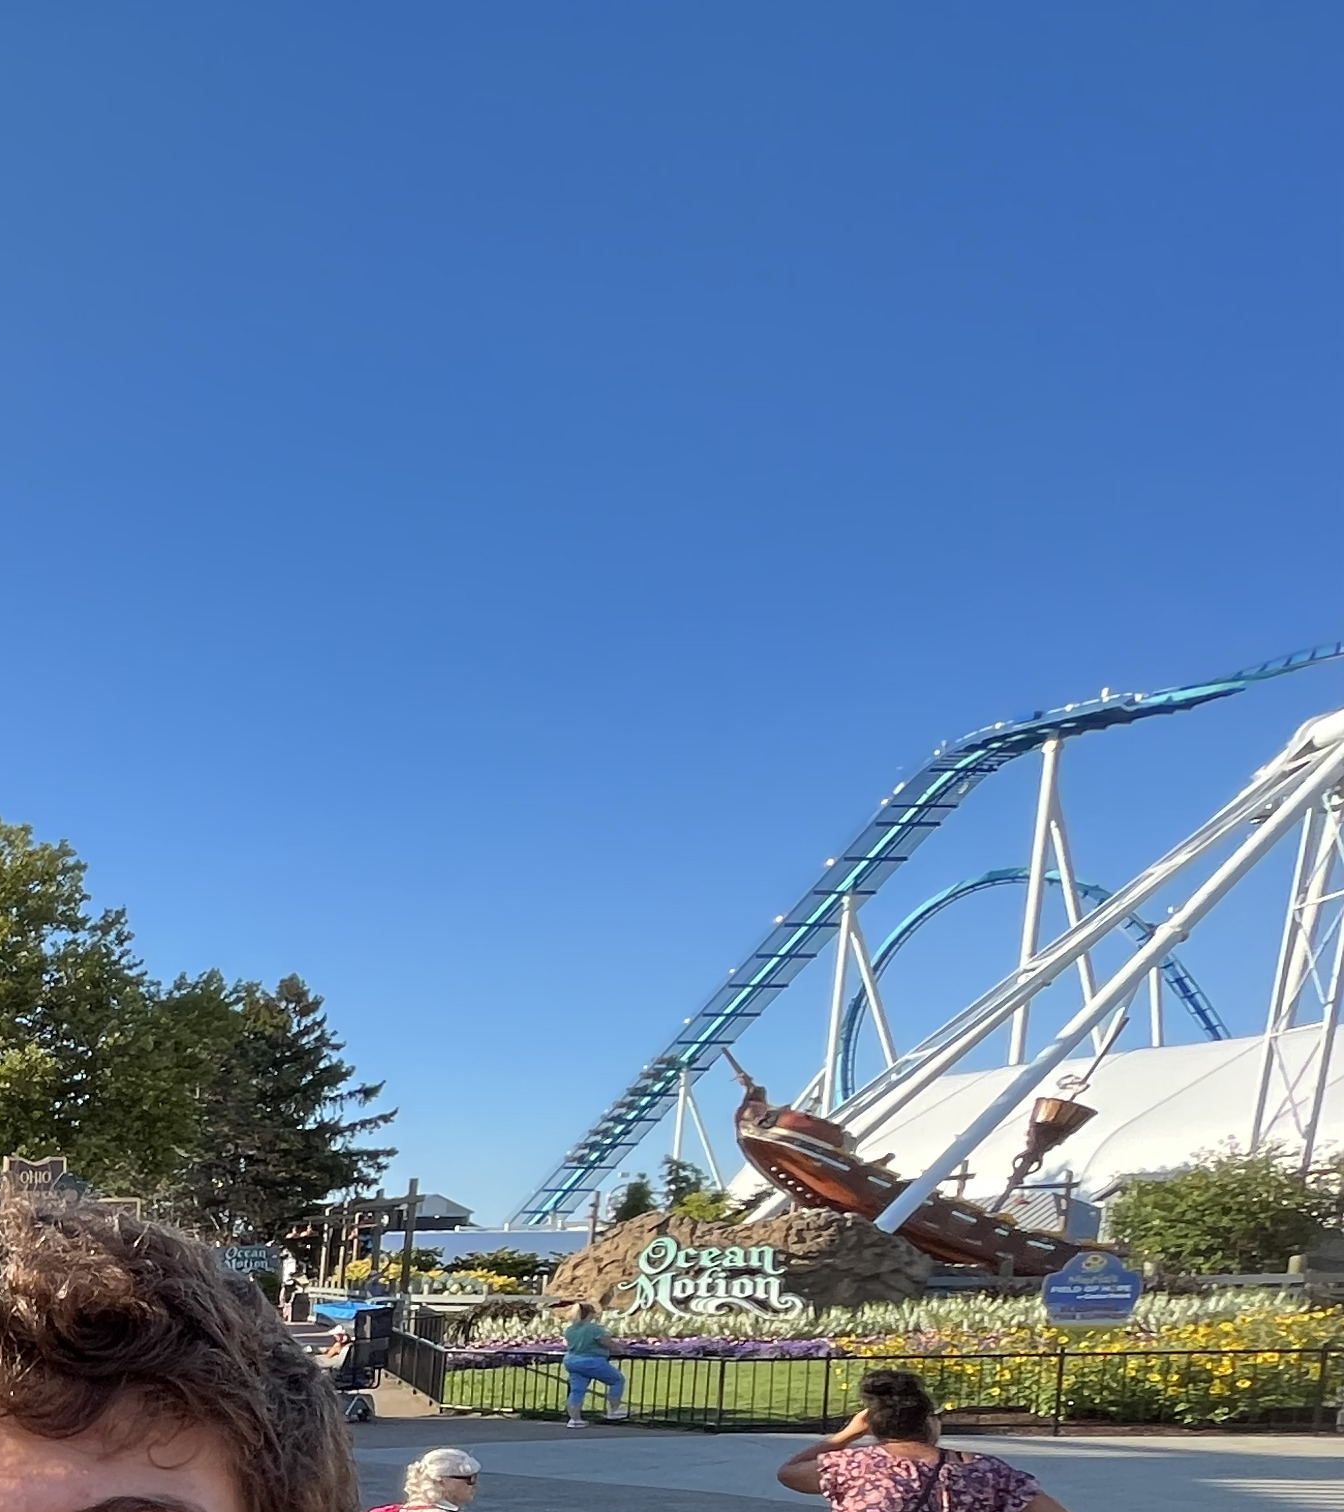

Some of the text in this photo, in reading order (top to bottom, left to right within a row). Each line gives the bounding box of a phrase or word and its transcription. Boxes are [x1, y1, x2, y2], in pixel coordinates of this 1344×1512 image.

[19, 1170, 52, 1184] OHIO
[225, 1246, 266, 1259] Ocean
[638, 1236, 788, 1275] Ocean
[617, 1267, 804, 1320] Motion
